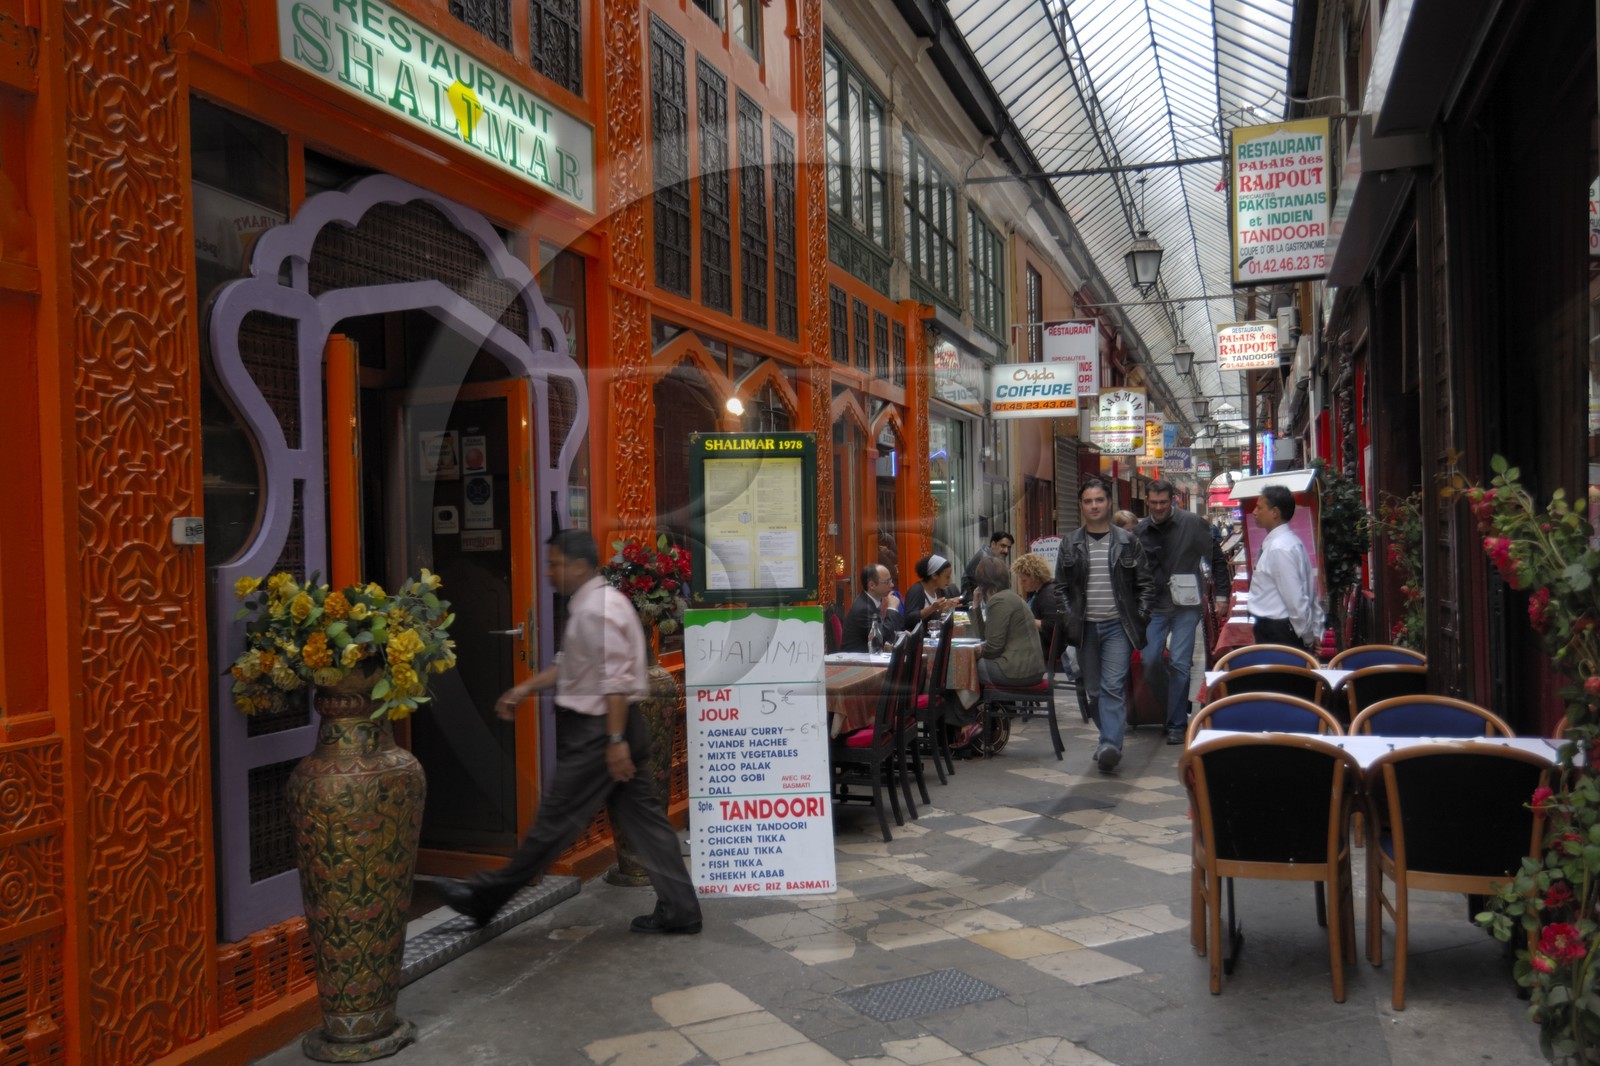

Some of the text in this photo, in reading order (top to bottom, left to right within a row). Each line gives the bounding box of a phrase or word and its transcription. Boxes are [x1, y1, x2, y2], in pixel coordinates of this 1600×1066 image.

[333, 0, 553, 134] RESTAURANT
[292, 2, 583, 200] SHALIMAR
[1238, 135, 1322, 160] RESTAURANT
[1238, 155, 1324, 172] PALAIS des
[1239, 167, 1324, 193] RAJPOUT
[1238, 192, 1327, 213] PAKISTANAIS
[1249, 210, 1313, 227] et INDIEN
[1240, 223, 1325, 244] TANDOORI
[1240, 246, 1259, 257] COUPE
[1286, 239, 1325, 252] GASTRONOMIE
[1048, 325, 1092, 336] RESTAURANT
[1232, 326, 1264, 334] RESTAURANT
[1219, 332, 1277, 344] PALAIS des
[1219, 341, 1277, 355] RAJPOUT
[996, 383, 1073, 398] COIFFURE
[995, 400, 1074, 412] 01.45.23.43.02
[1101, 392, 1143, 412] YASMIN
[704, 439, 803, 450] SHALIMAR 1978
[697, 688, 732, 702] PLAT
[699, 708, 739, 721] JOUR
[707, 727, 784, 737] AGNEAU CURRY
[707, 738, 788, 749] VIANDE HACHEE
[707, 749, 798, 760] MIXTE VEGETABLES
[708, 761, 771, 772] ALOO PALAK
[709, 773, 765, 784] ALOO GOBI
[708, 787, 732, 795] DALL
[720, 797, 825, 820] TANDOORI
[707, 821, 807, 834] CHICKEN TANDOORI
[708, 834, 786, 845] CHICKEN TIKKA
[709, 846, 783, 857] AGNEAU TIKKA
[709, 858, 763, 869] FISH TIKKA
[709, 869, 784, 881] SHEEKH KABAB
[699, 880, 830, 894] SERVI AVEC RIZ BASMATI
